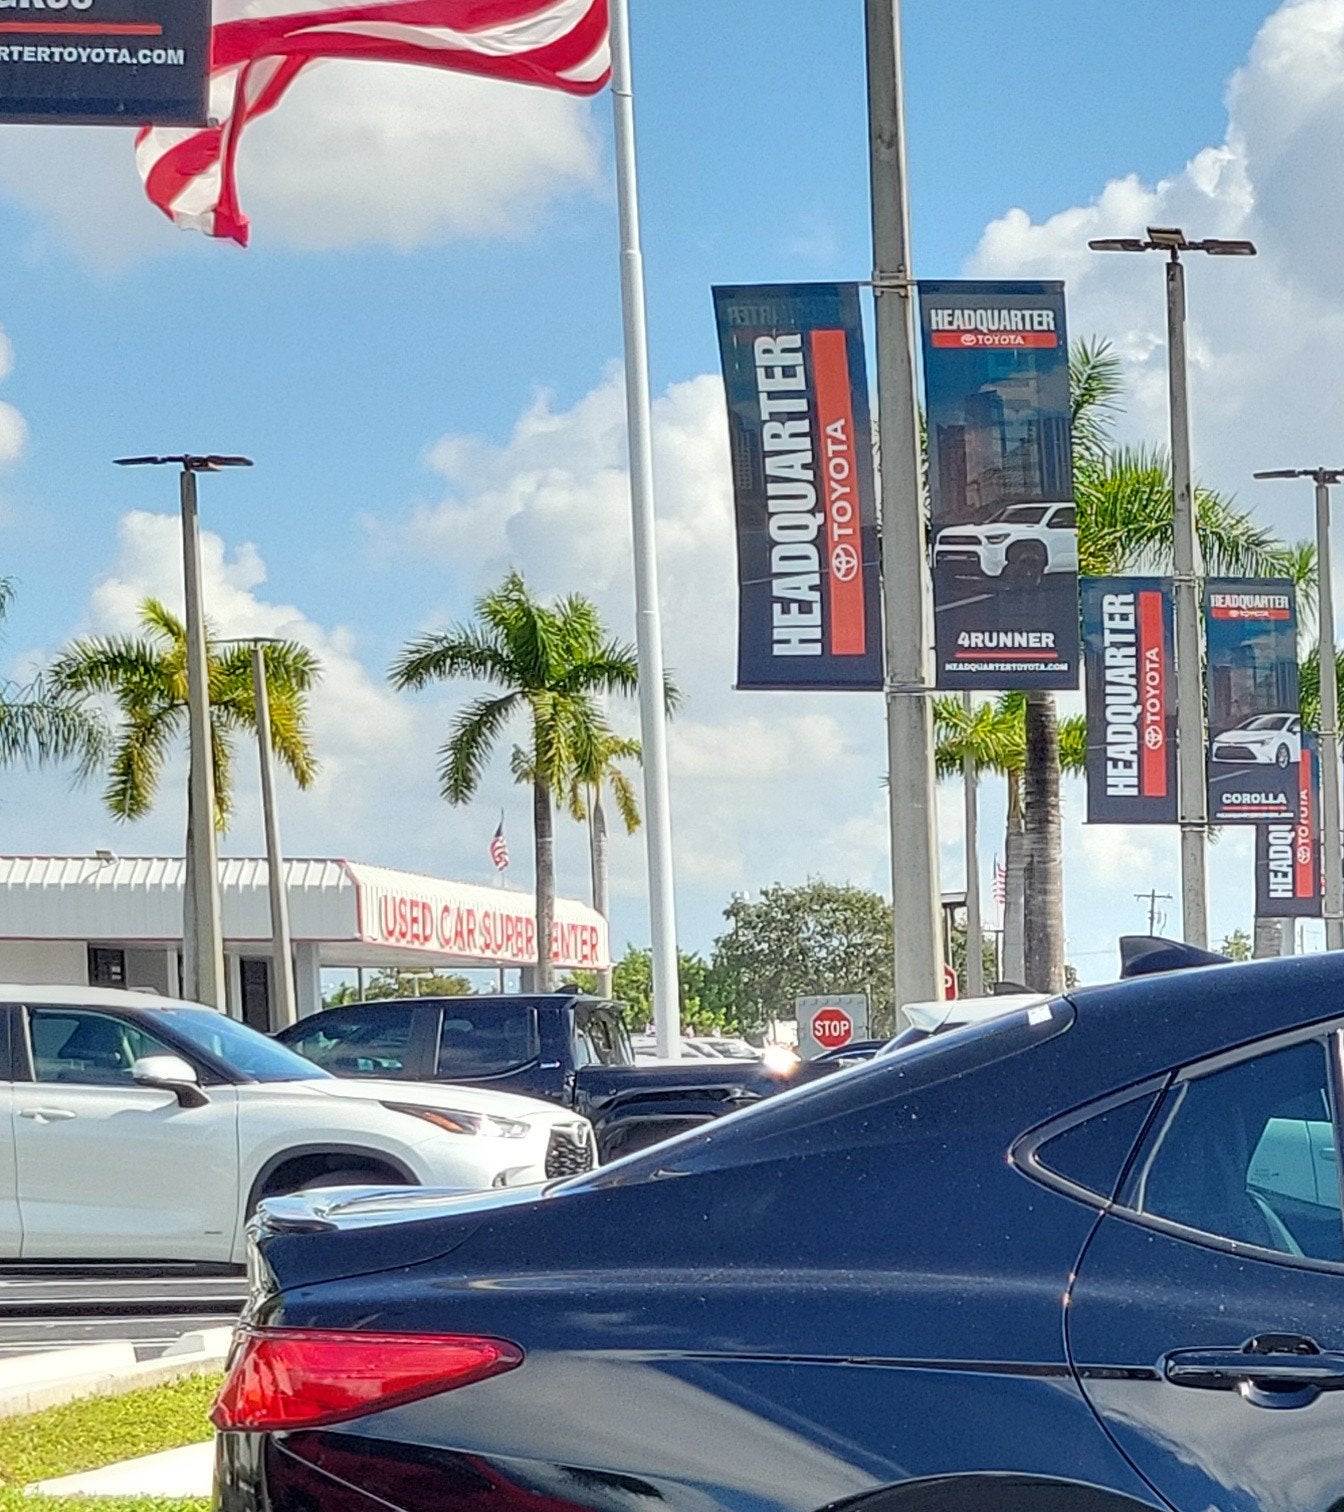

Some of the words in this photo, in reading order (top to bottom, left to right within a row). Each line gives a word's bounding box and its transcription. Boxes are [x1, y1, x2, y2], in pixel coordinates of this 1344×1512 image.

[930, 309, 1055, 333] HEADQUARTER
[977, 334, 1024, 345] TOYOTA
[827, 418, 855, 541] TOYOTA
[754, 333, 823, 656] HEADQUARTER
[1210, 594, 1289, 609] HEADQUARTER
[957, 631, 1055, 648] 4RUNNER
[1102, 592, 1142, 797] HEADQUARTER
[1145, 647, 1160, 723] TOYOTA
[1222, 793, 1287, 804] COROLLA
[383, 895, 433, 942] USED
[440, 905, 476, 950] CAR
[483, 911, 535, 956] SUPER
[550, 922, 599, 963] ENTER
[814, 1020, 850, 1037] STOP
